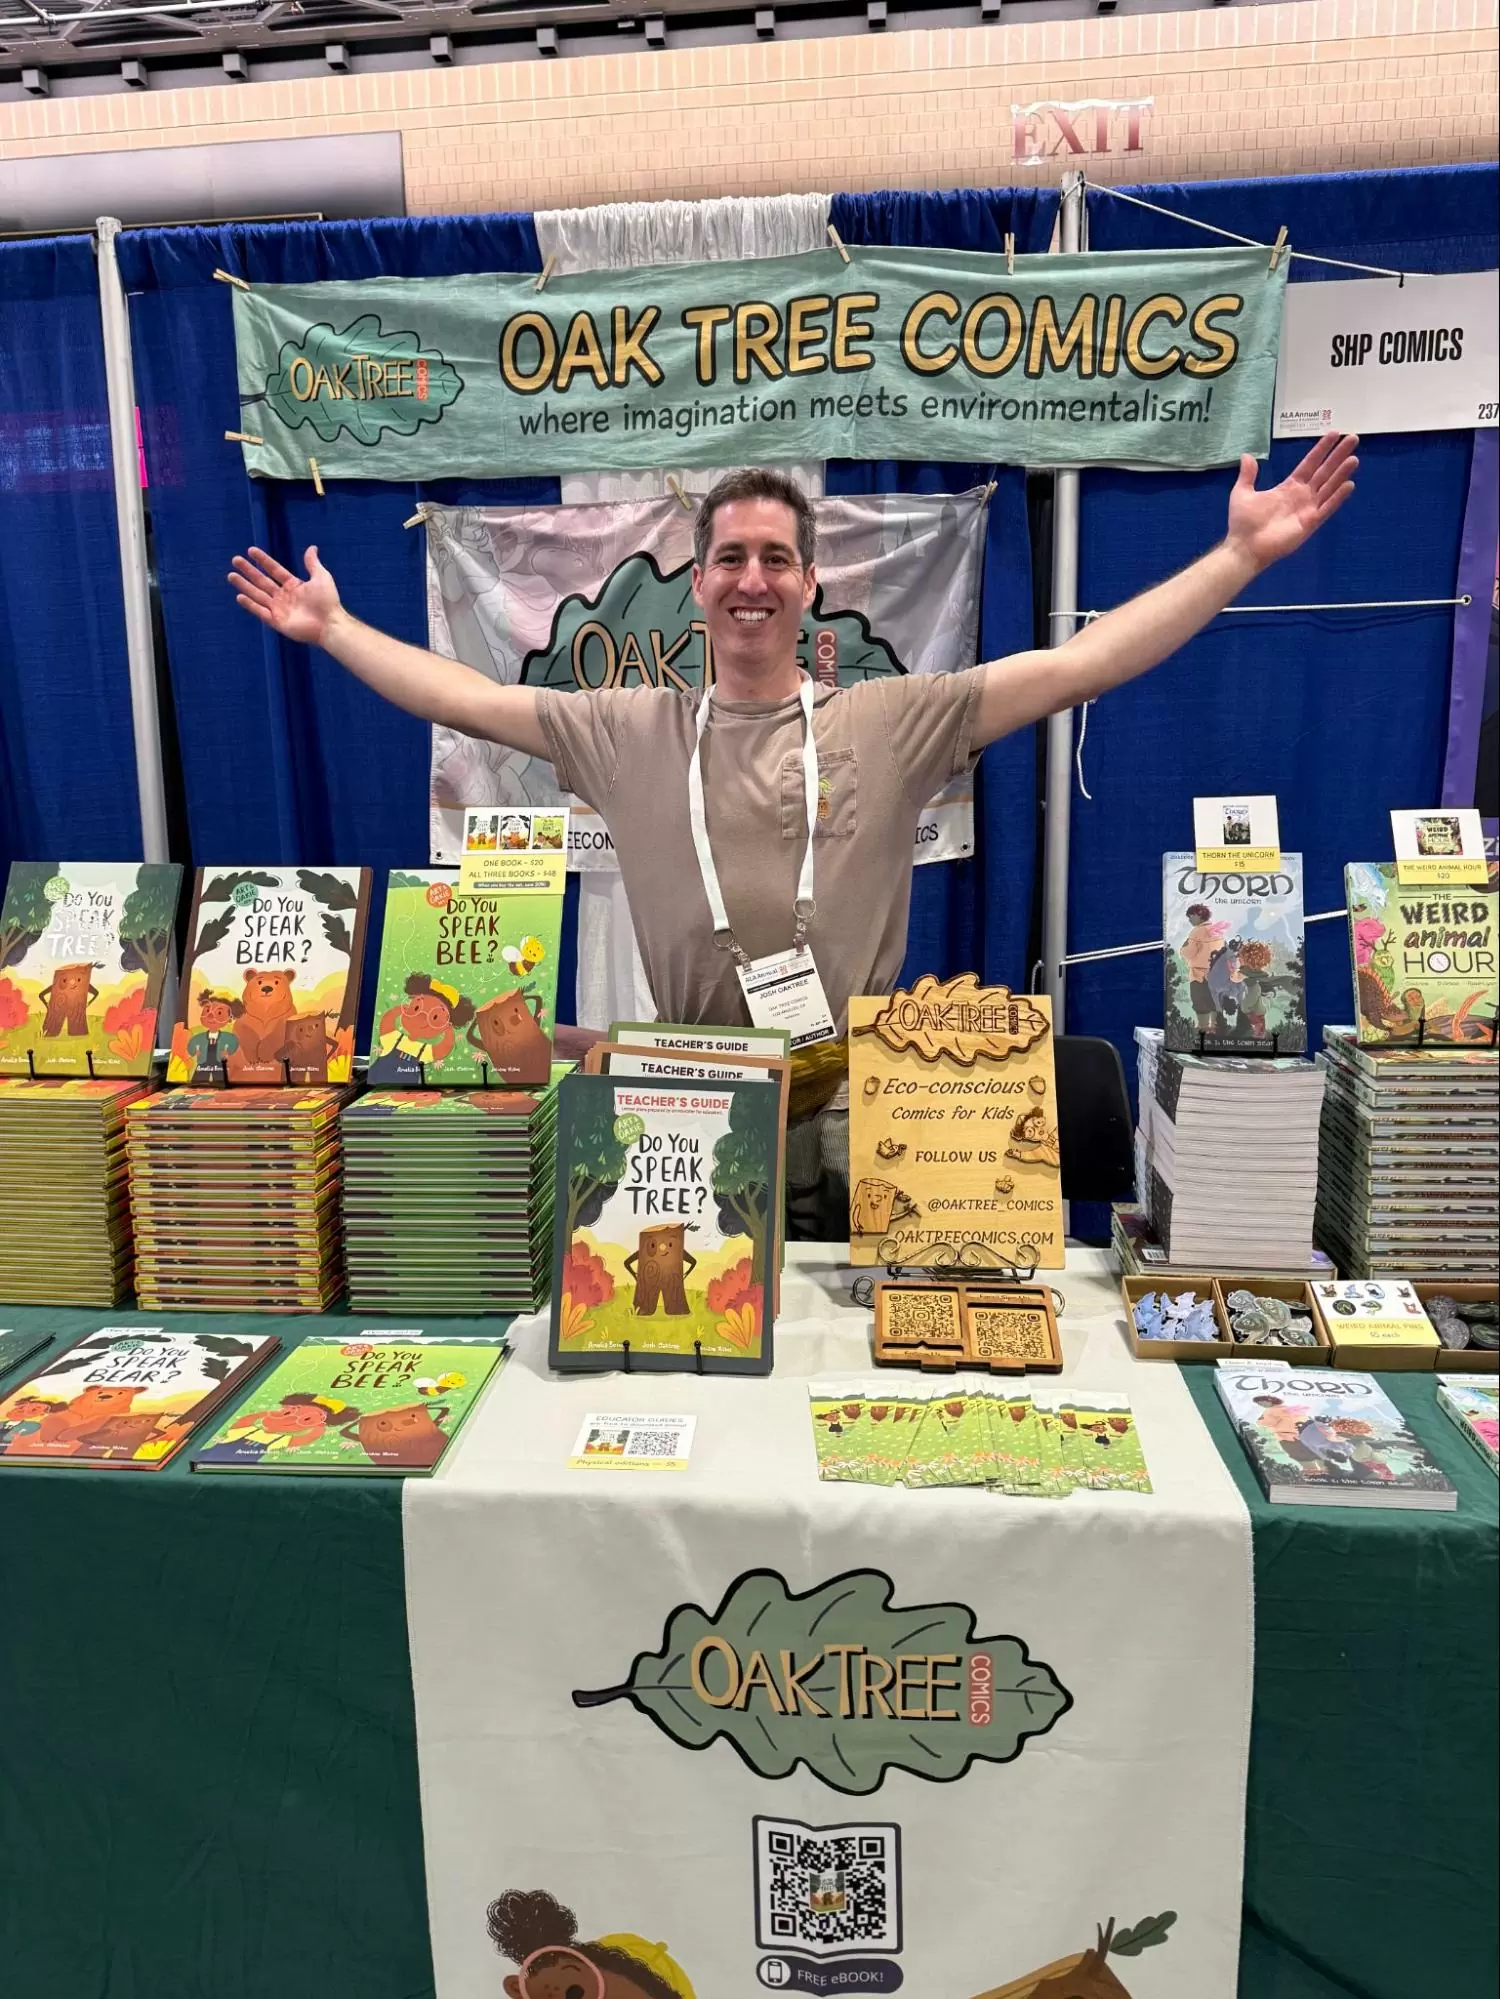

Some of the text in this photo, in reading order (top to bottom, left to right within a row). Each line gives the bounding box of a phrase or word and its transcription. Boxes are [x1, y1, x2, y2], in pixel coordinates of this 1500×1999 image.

[1011, 98, 1154, 162] EXIT
[499, 290, 1244, 395] OAK TREE COMICS
[1330, 327, 1464, 368] SHP COMICS
[519, 386, 1214, 437] where imagination meets environmentalism!
[817, 631, 836, 688] COMIC
[501, 859, 523, 867] BOOK
[1400, 902, 1489, 925] WEIRD
[244, 914, 306, 938] SPEAK
[439, 915, 500, 938] SPEAK
[1403, 926, 1491, 948] animal
[236, 939, 312, 965] BEAR?
[436, 940, 499, 965] BEE?
[1403, 951, 1497, 974] HOUR
[760, 979, 809, 999] JOSH OAKTREE
[654, 1038, 749, 1052] TEACHER'S GUIDE
[641, 1062, 744, 1079] TEACHER'S GUIDE
[883, 1078, 1025, 1095] Eco-conscious
[617, 1094, 730, 1110] TEACHER'S GUIDE
[891, 1105, 1015, 1121] Comics for Kids
[915, 1150, 997, 1163] FOLLOW US
[630, 1155, 703, 1184] SPEAK
[624, 1186, 707, 1215] TREE?
[106, 1356, 187, 1368] SPEAK
[343, 1360, 423, 1373] SPEAK
[83, 1369, 182, 1384] BEAR?
[330, 1374, 411, 1389] BEE?
[969, 1653, 992, 1725] COMICS
[797, 1969, 884, 1987] FREE eBOOK!
